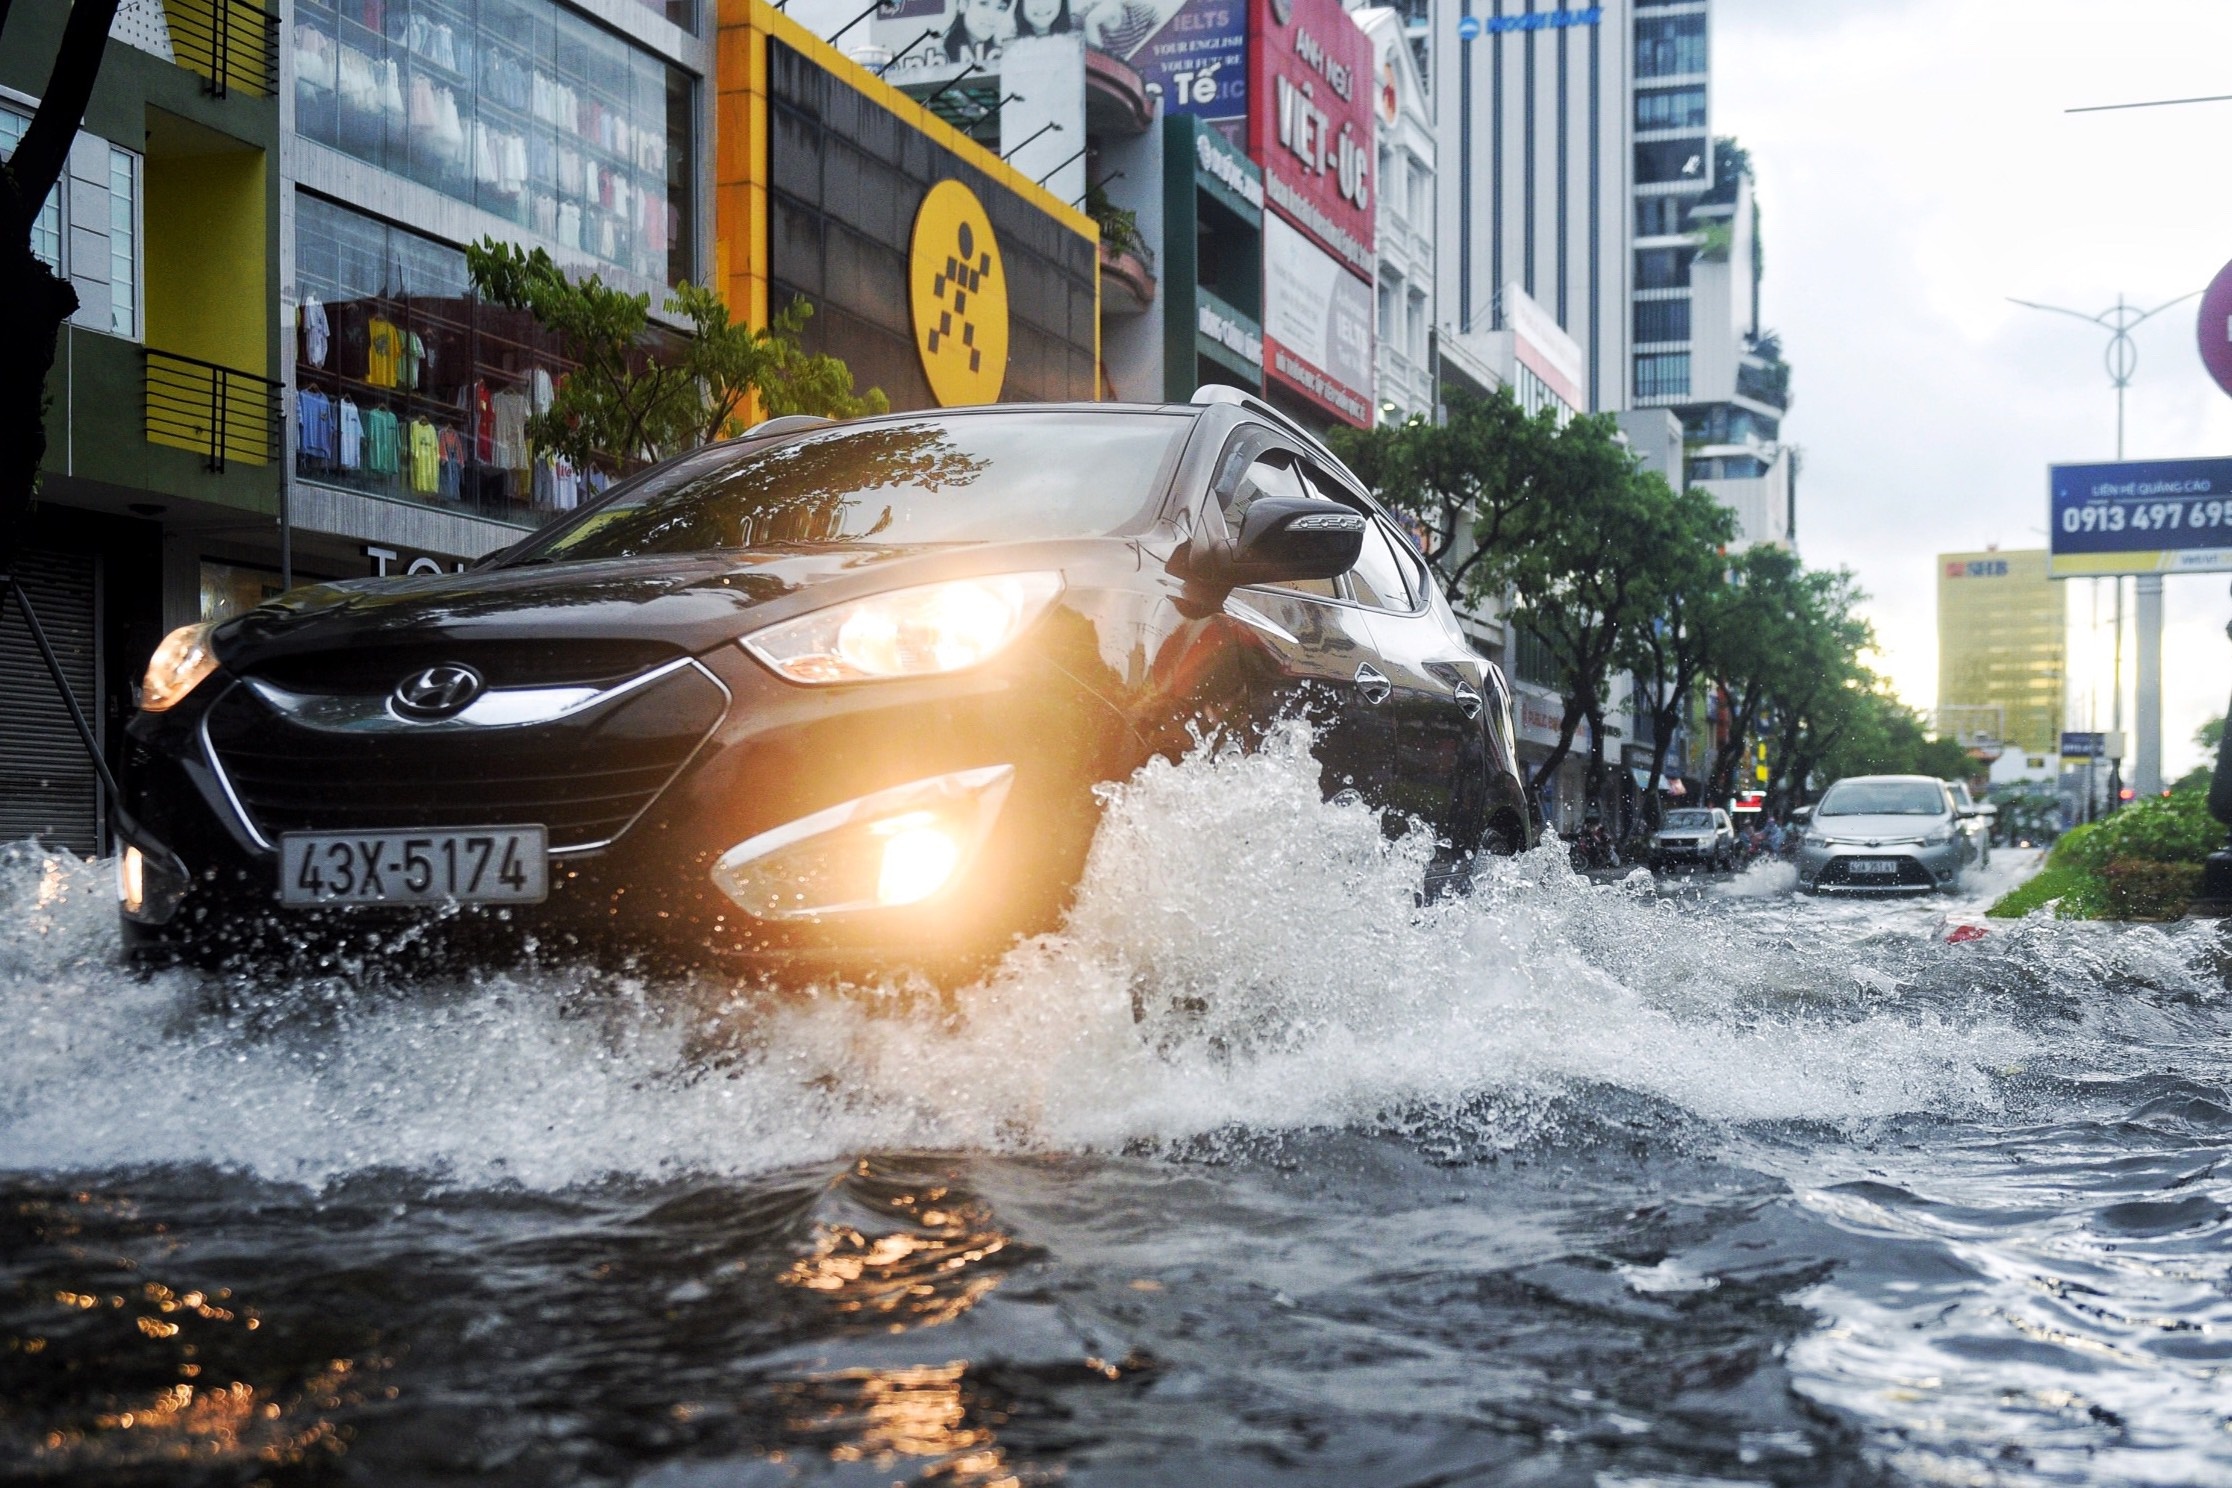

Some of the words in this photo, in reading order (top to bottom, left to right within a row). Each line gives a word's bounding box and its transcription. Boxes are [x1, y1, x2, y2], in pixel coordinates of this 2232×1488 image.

[1174, 10, 1229, 31] IELTS
[1153, 41, 1187, 56] YOUR
[1296, 27, 1325, 75] ANH
[1173, 61, 1221, 105] Tế
[2062, 505, 2126, 533] 0913
[2131, 503, 2183, 531] 497
[298, 836, 527, 897] 43X-5174
